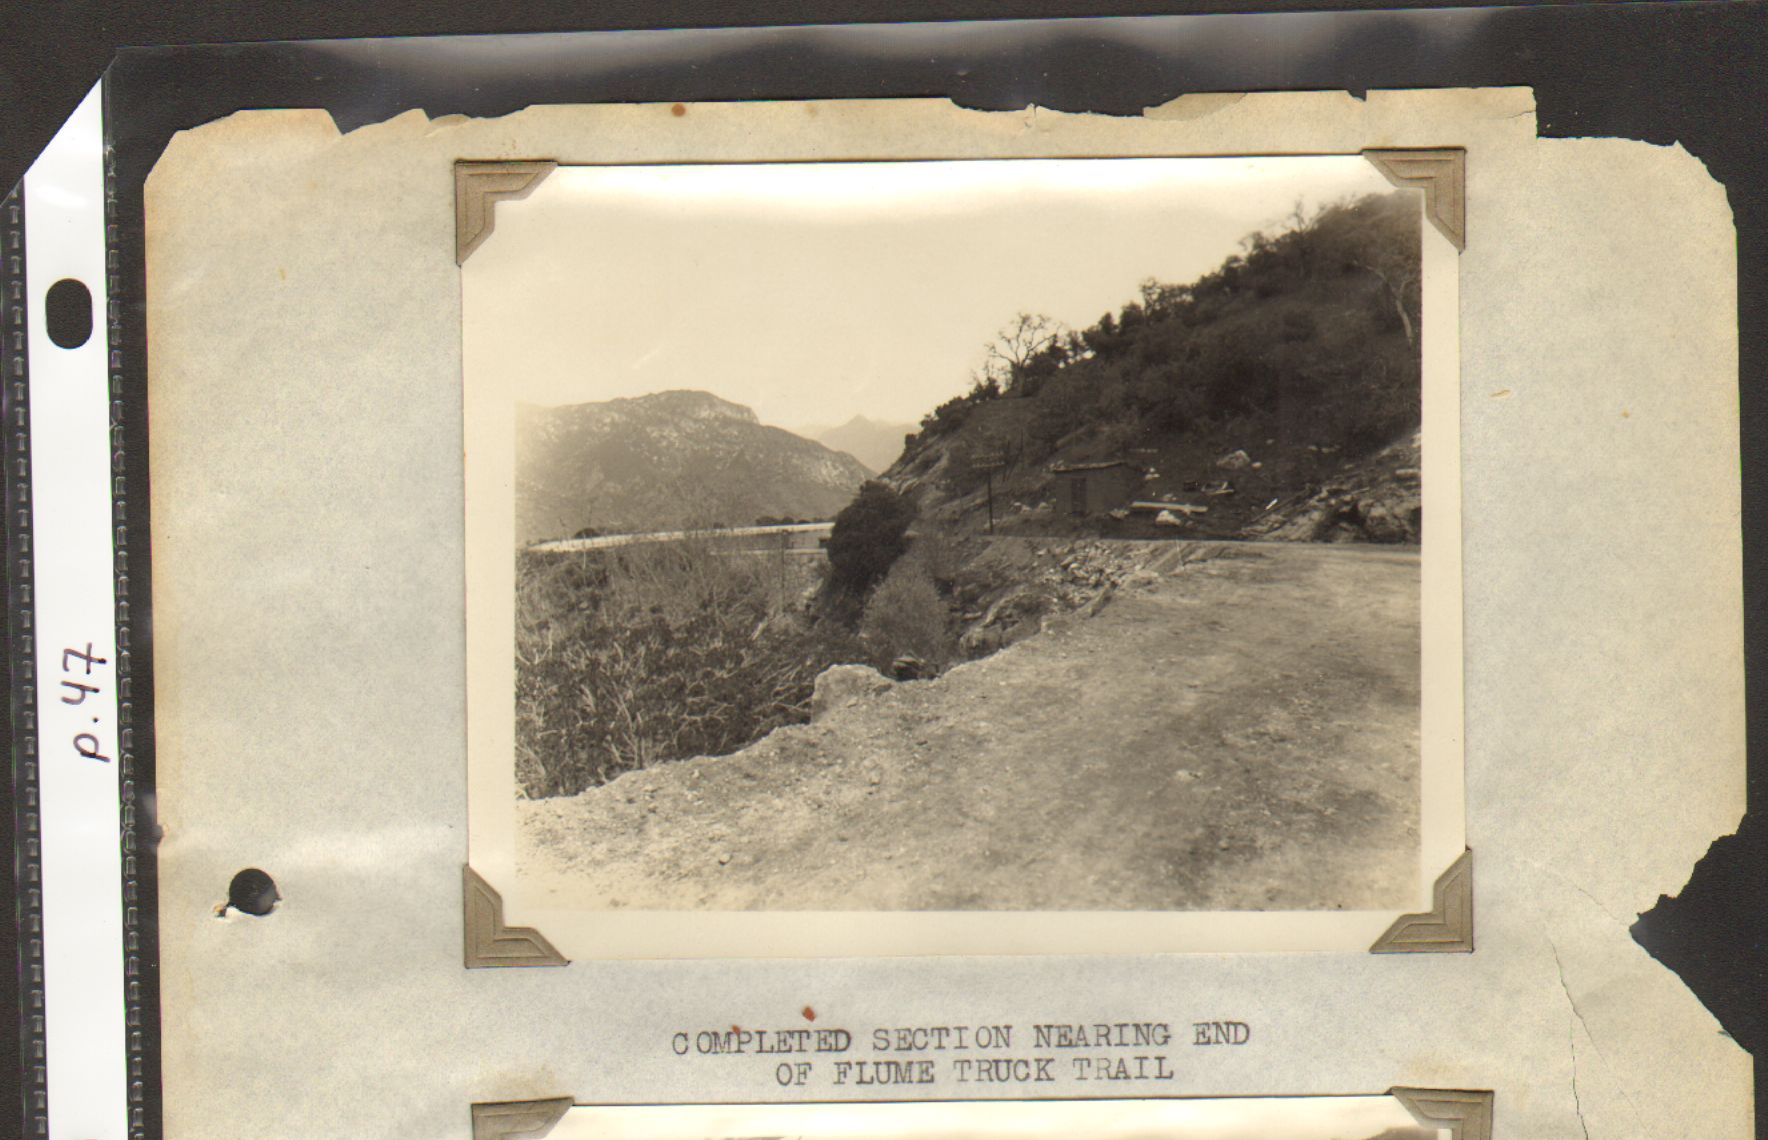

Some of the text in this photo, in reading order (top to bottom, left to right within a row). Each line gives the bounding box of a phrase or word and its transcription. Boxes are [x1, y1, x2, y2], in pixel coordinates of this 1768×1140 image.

[671, 1021, 1252, 1056] COMPLETED SECTION NEARING END
[775, 1056, 1175, 1086] OF FLUME TRUCK TRAIL
